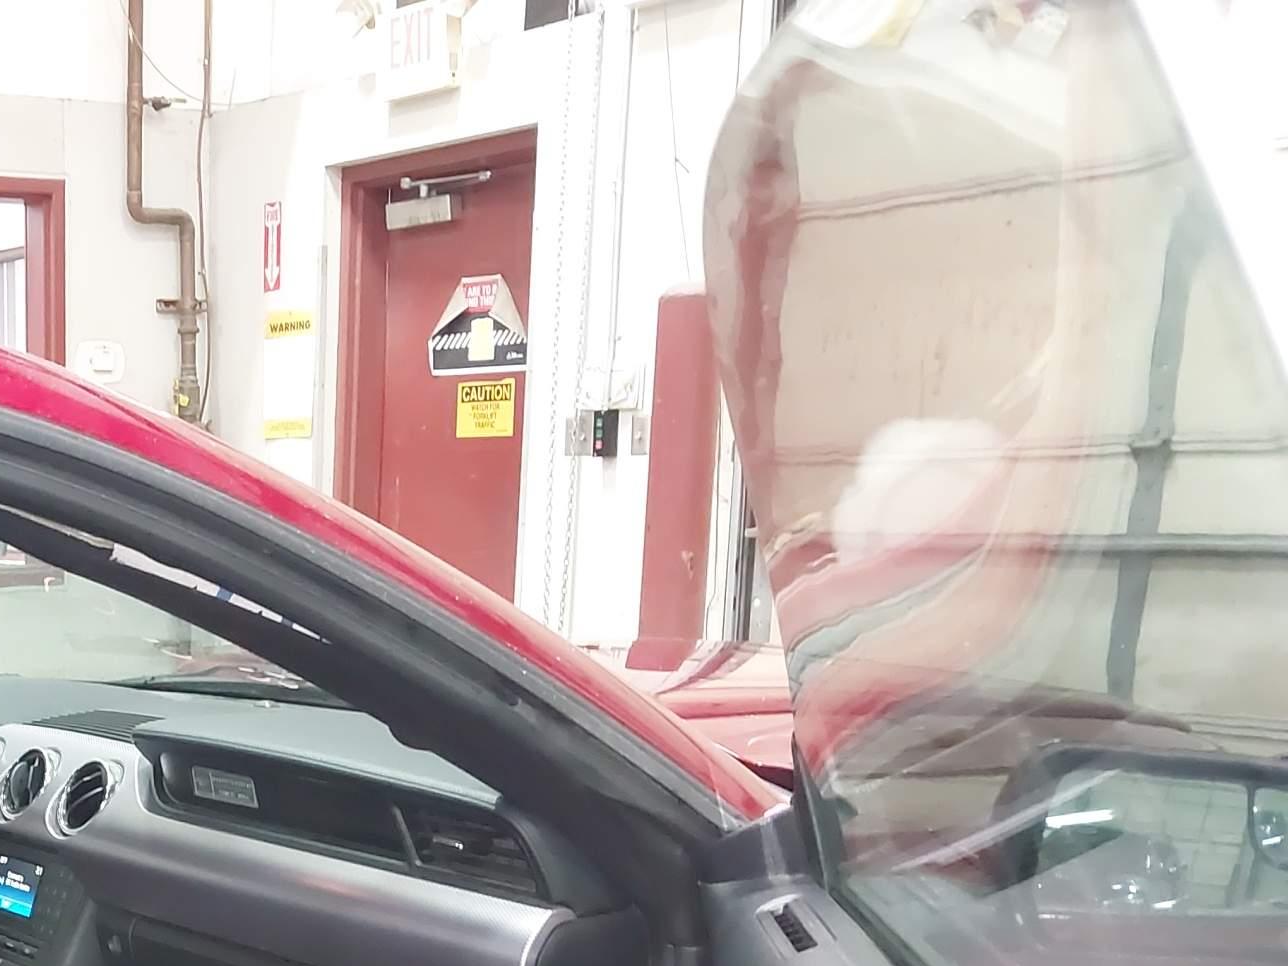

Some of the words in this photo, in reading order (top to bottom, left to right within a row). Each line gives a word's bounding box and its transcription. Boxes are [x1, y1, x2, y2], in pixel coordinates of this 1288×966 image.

[390, 7, 434, 69] EXIT
[269, 320, 311, 334] WARNING
[462, 384, 511, 402] CAUTION
[475, 421, 496, 429] TRAFFIC
